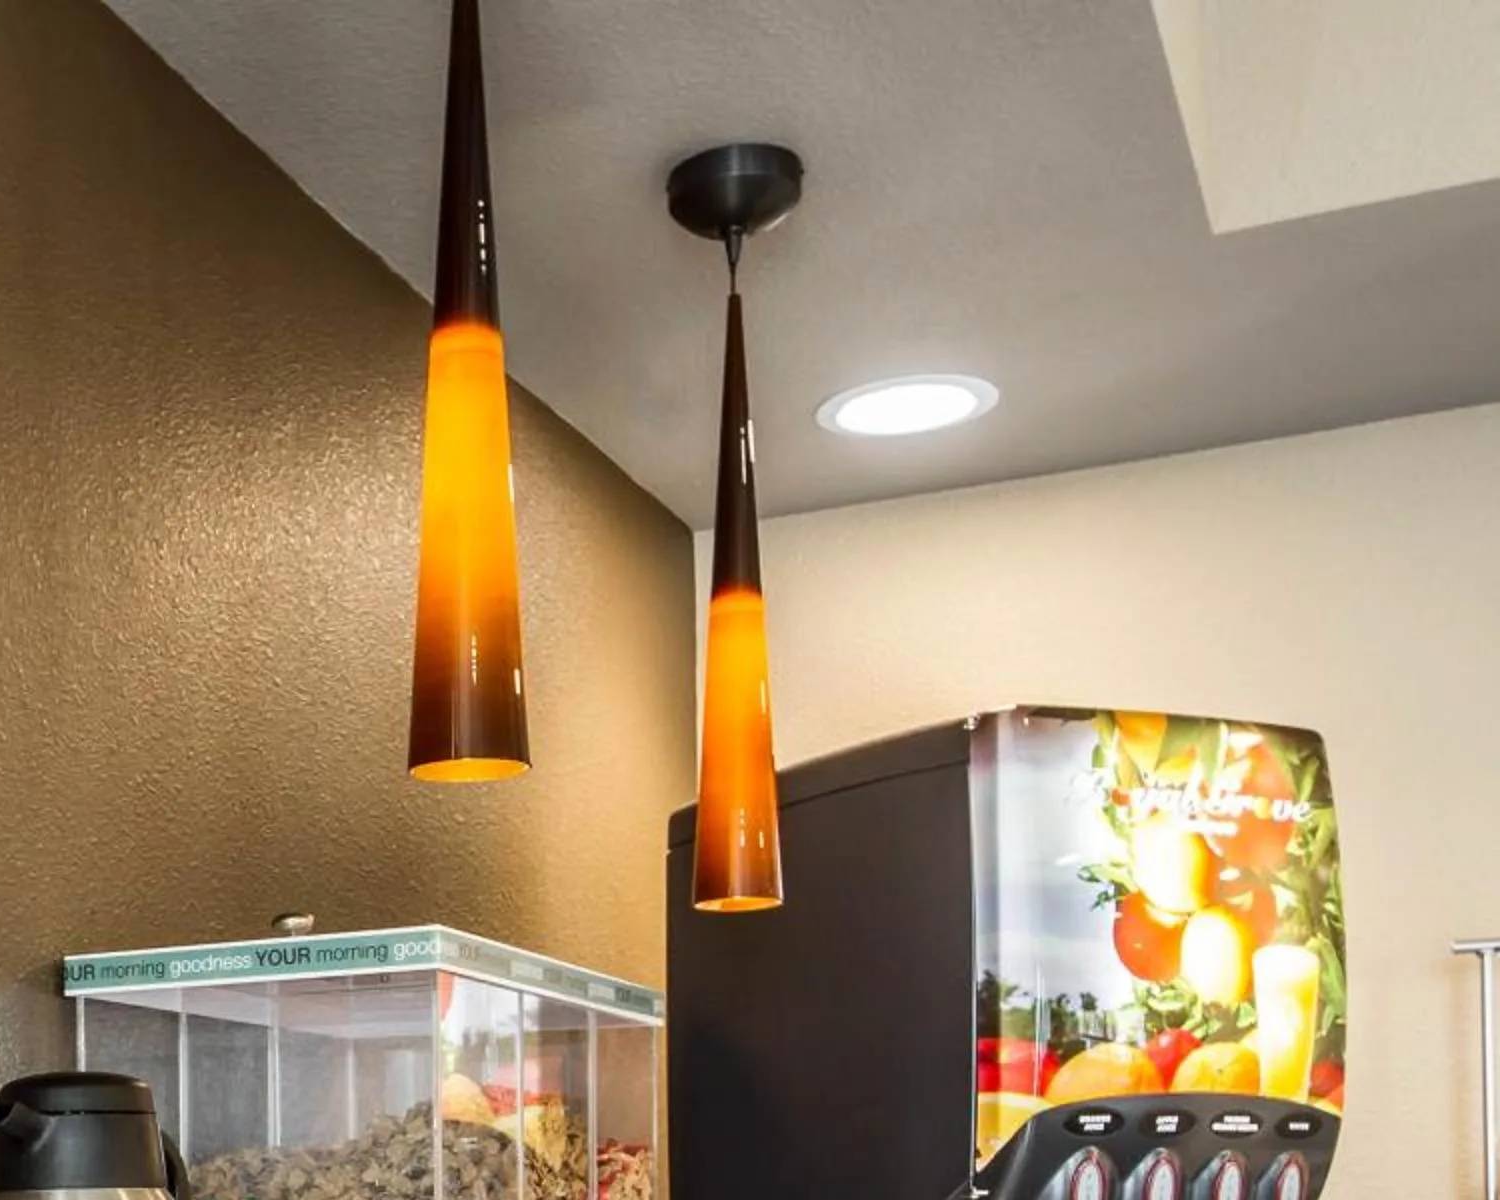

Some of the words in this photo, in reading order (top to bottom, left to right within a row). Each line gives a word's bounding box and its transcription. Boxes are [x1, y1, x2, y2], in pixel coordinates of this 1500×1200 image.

[101, 960, 165, 979] morning
[170, 954, 253, 979] goodness
[255, 946, 311, 967] YOUR
[316, 943, 389, 963] morning
